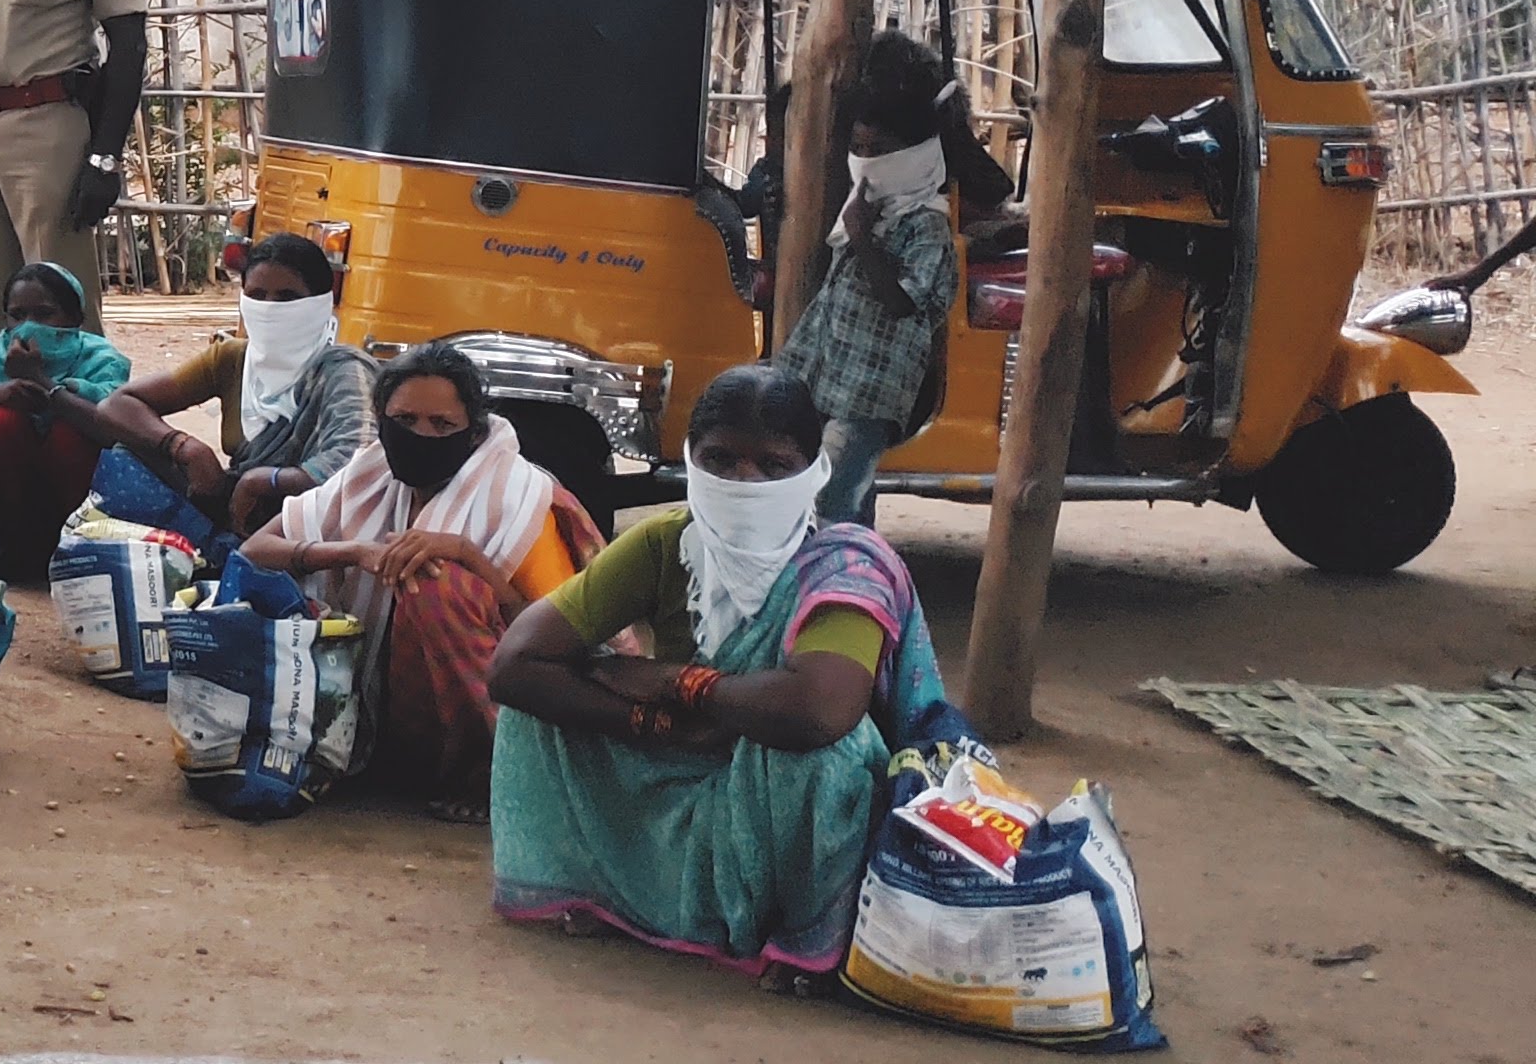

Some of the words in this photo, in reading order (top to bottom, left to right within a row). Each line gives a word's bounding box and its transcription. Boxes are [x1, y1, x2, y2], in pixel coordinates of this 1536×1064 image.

[484, 237, 567, 264] Capacity
[577, 250, 589, 263] 4
[597, 251, 645, 272] Only
